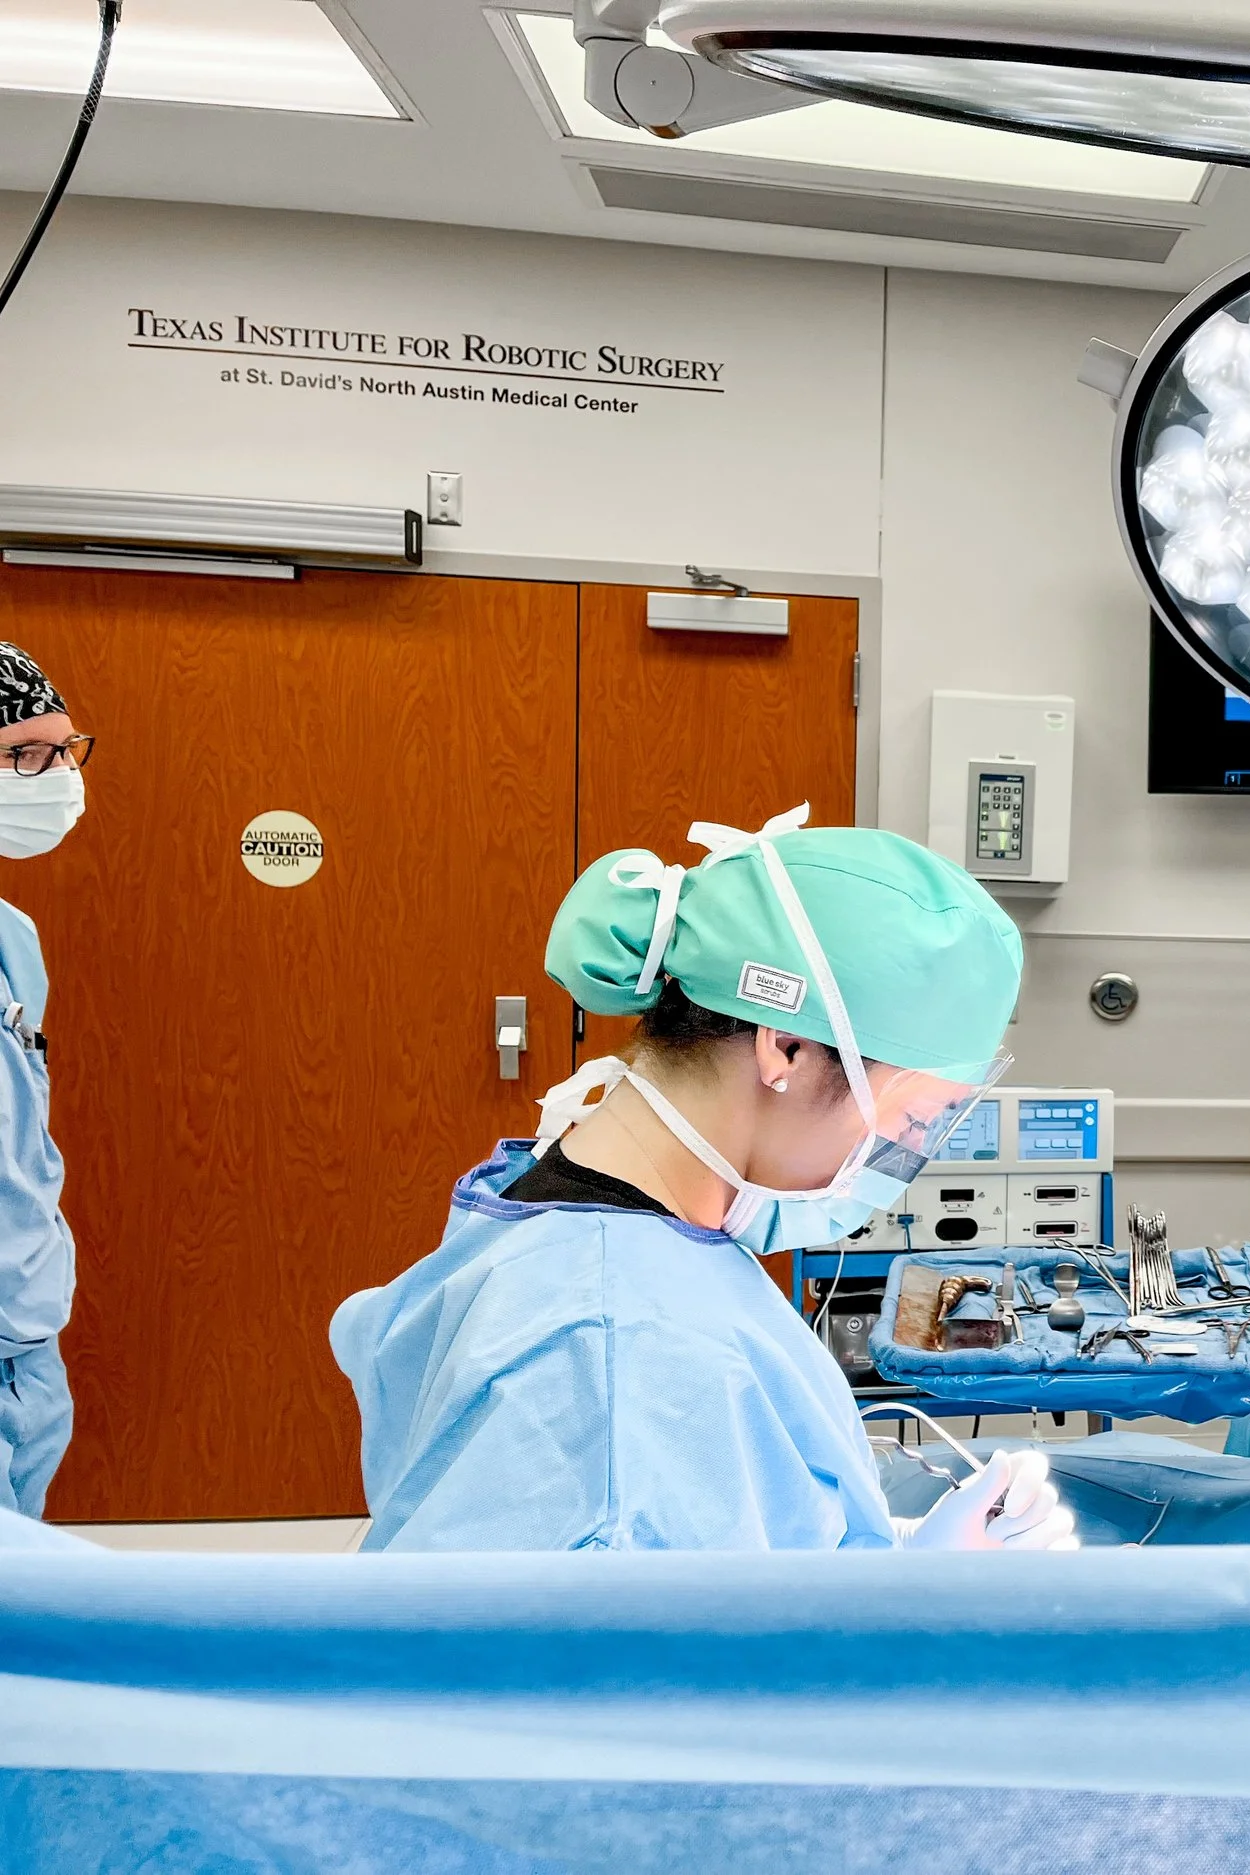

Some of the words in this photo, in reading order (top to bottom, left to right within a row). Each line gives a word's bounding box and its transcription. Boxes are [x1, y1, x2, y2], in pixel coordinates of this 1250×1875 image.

[397, 334, 451, 361] FOR
[220, 368, 240, 383] at
[246, 368, 274, 386] St.
[280, 370, 353, 392] David's
[358, 376, 417, 397] North
[422, 382, 485, 402] Austin
[491, 387, 568, 409] Medical
[574, 394, 639, 414] Center
[246, 831, 318, 843] AUTOMATIC
[241, 842, 322, 857] CAUTION
[263, 857, 299, 867] DOOR
[756, 974, 774, 985] blue
[775, 981, 790, 992] sky
